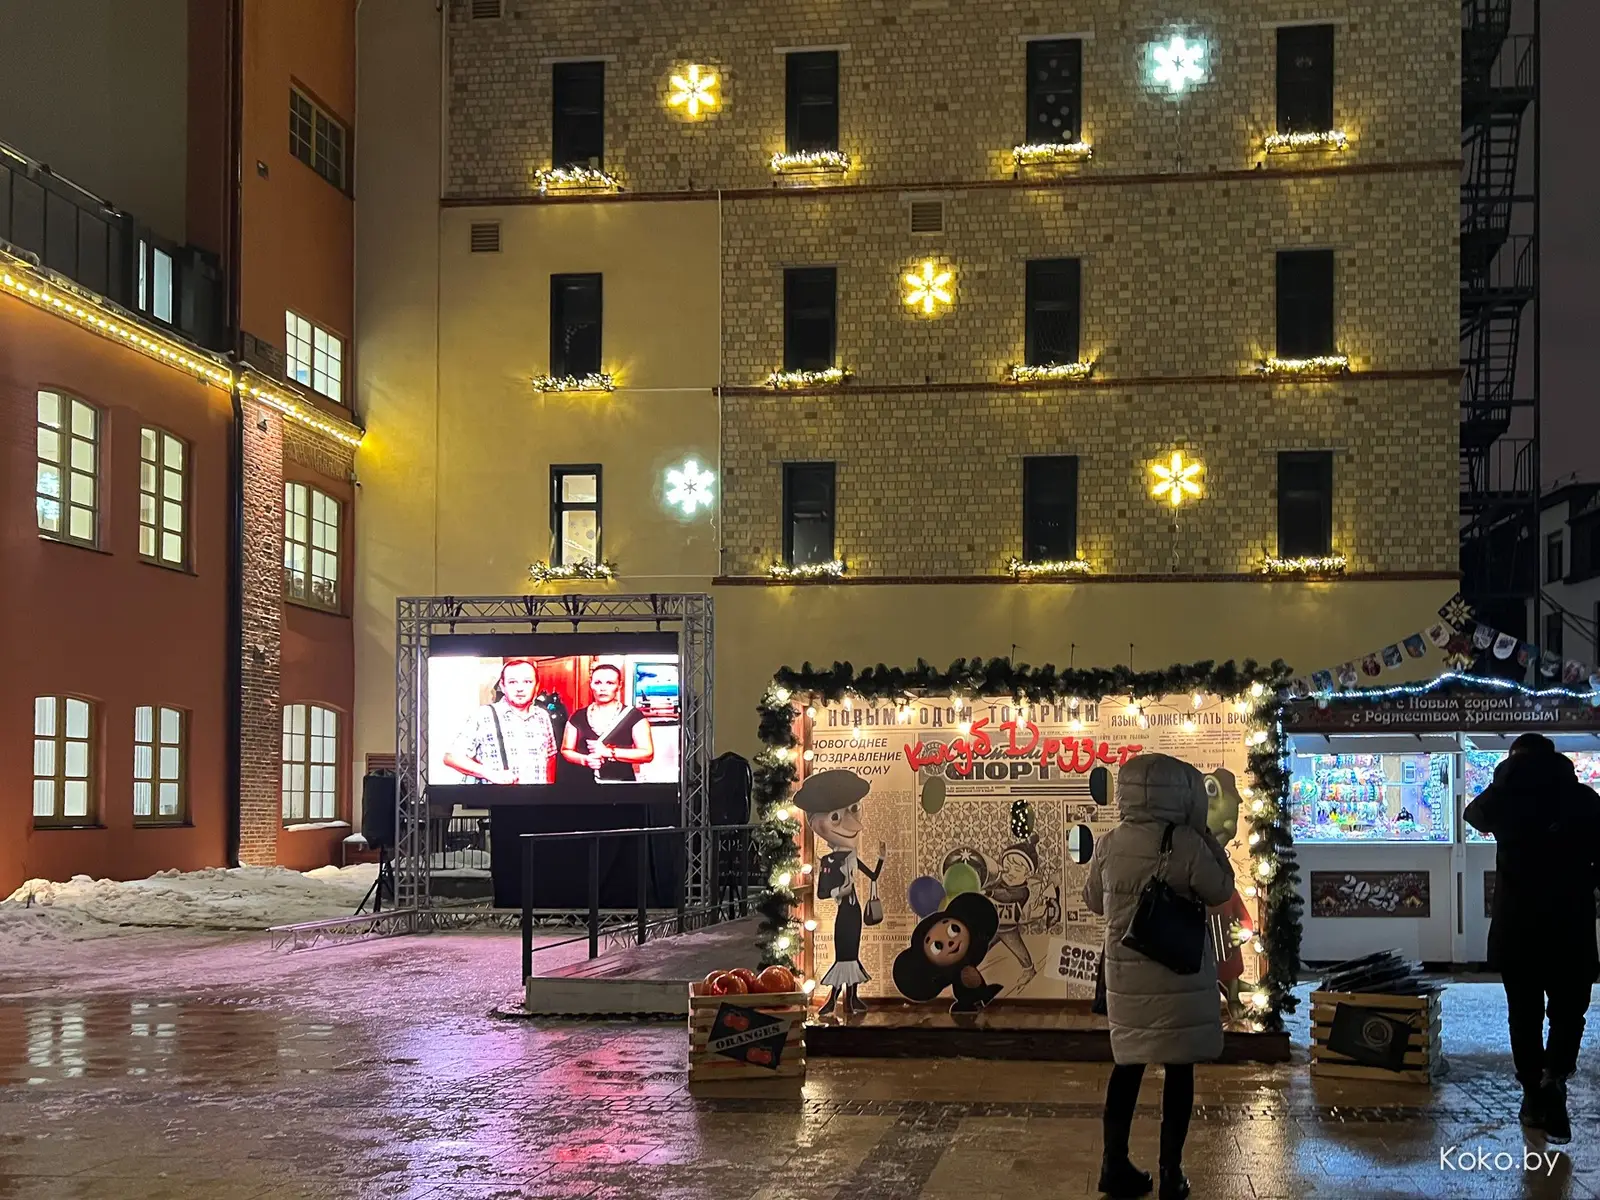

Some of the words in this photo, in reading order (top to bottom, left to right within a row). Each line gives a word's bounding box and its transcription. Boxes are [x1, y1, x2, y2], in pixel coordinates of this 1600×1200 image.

[1409, 697, 1459, 709] Новым
[1464, 696, 1513, 711] годом!
[828, 707, 896, 727] НОВЫМ
[1465, 708, 1559, 724] Христовым!
[812, 738, 888, 749] НОВОГОДНЕЕ
[813, 752, 902, 764] ПОЗДРАВЛЕНИЕ
[1338, 874, 1399, 912] 2023
[715, 1024, 781, 1050] ORANGES
